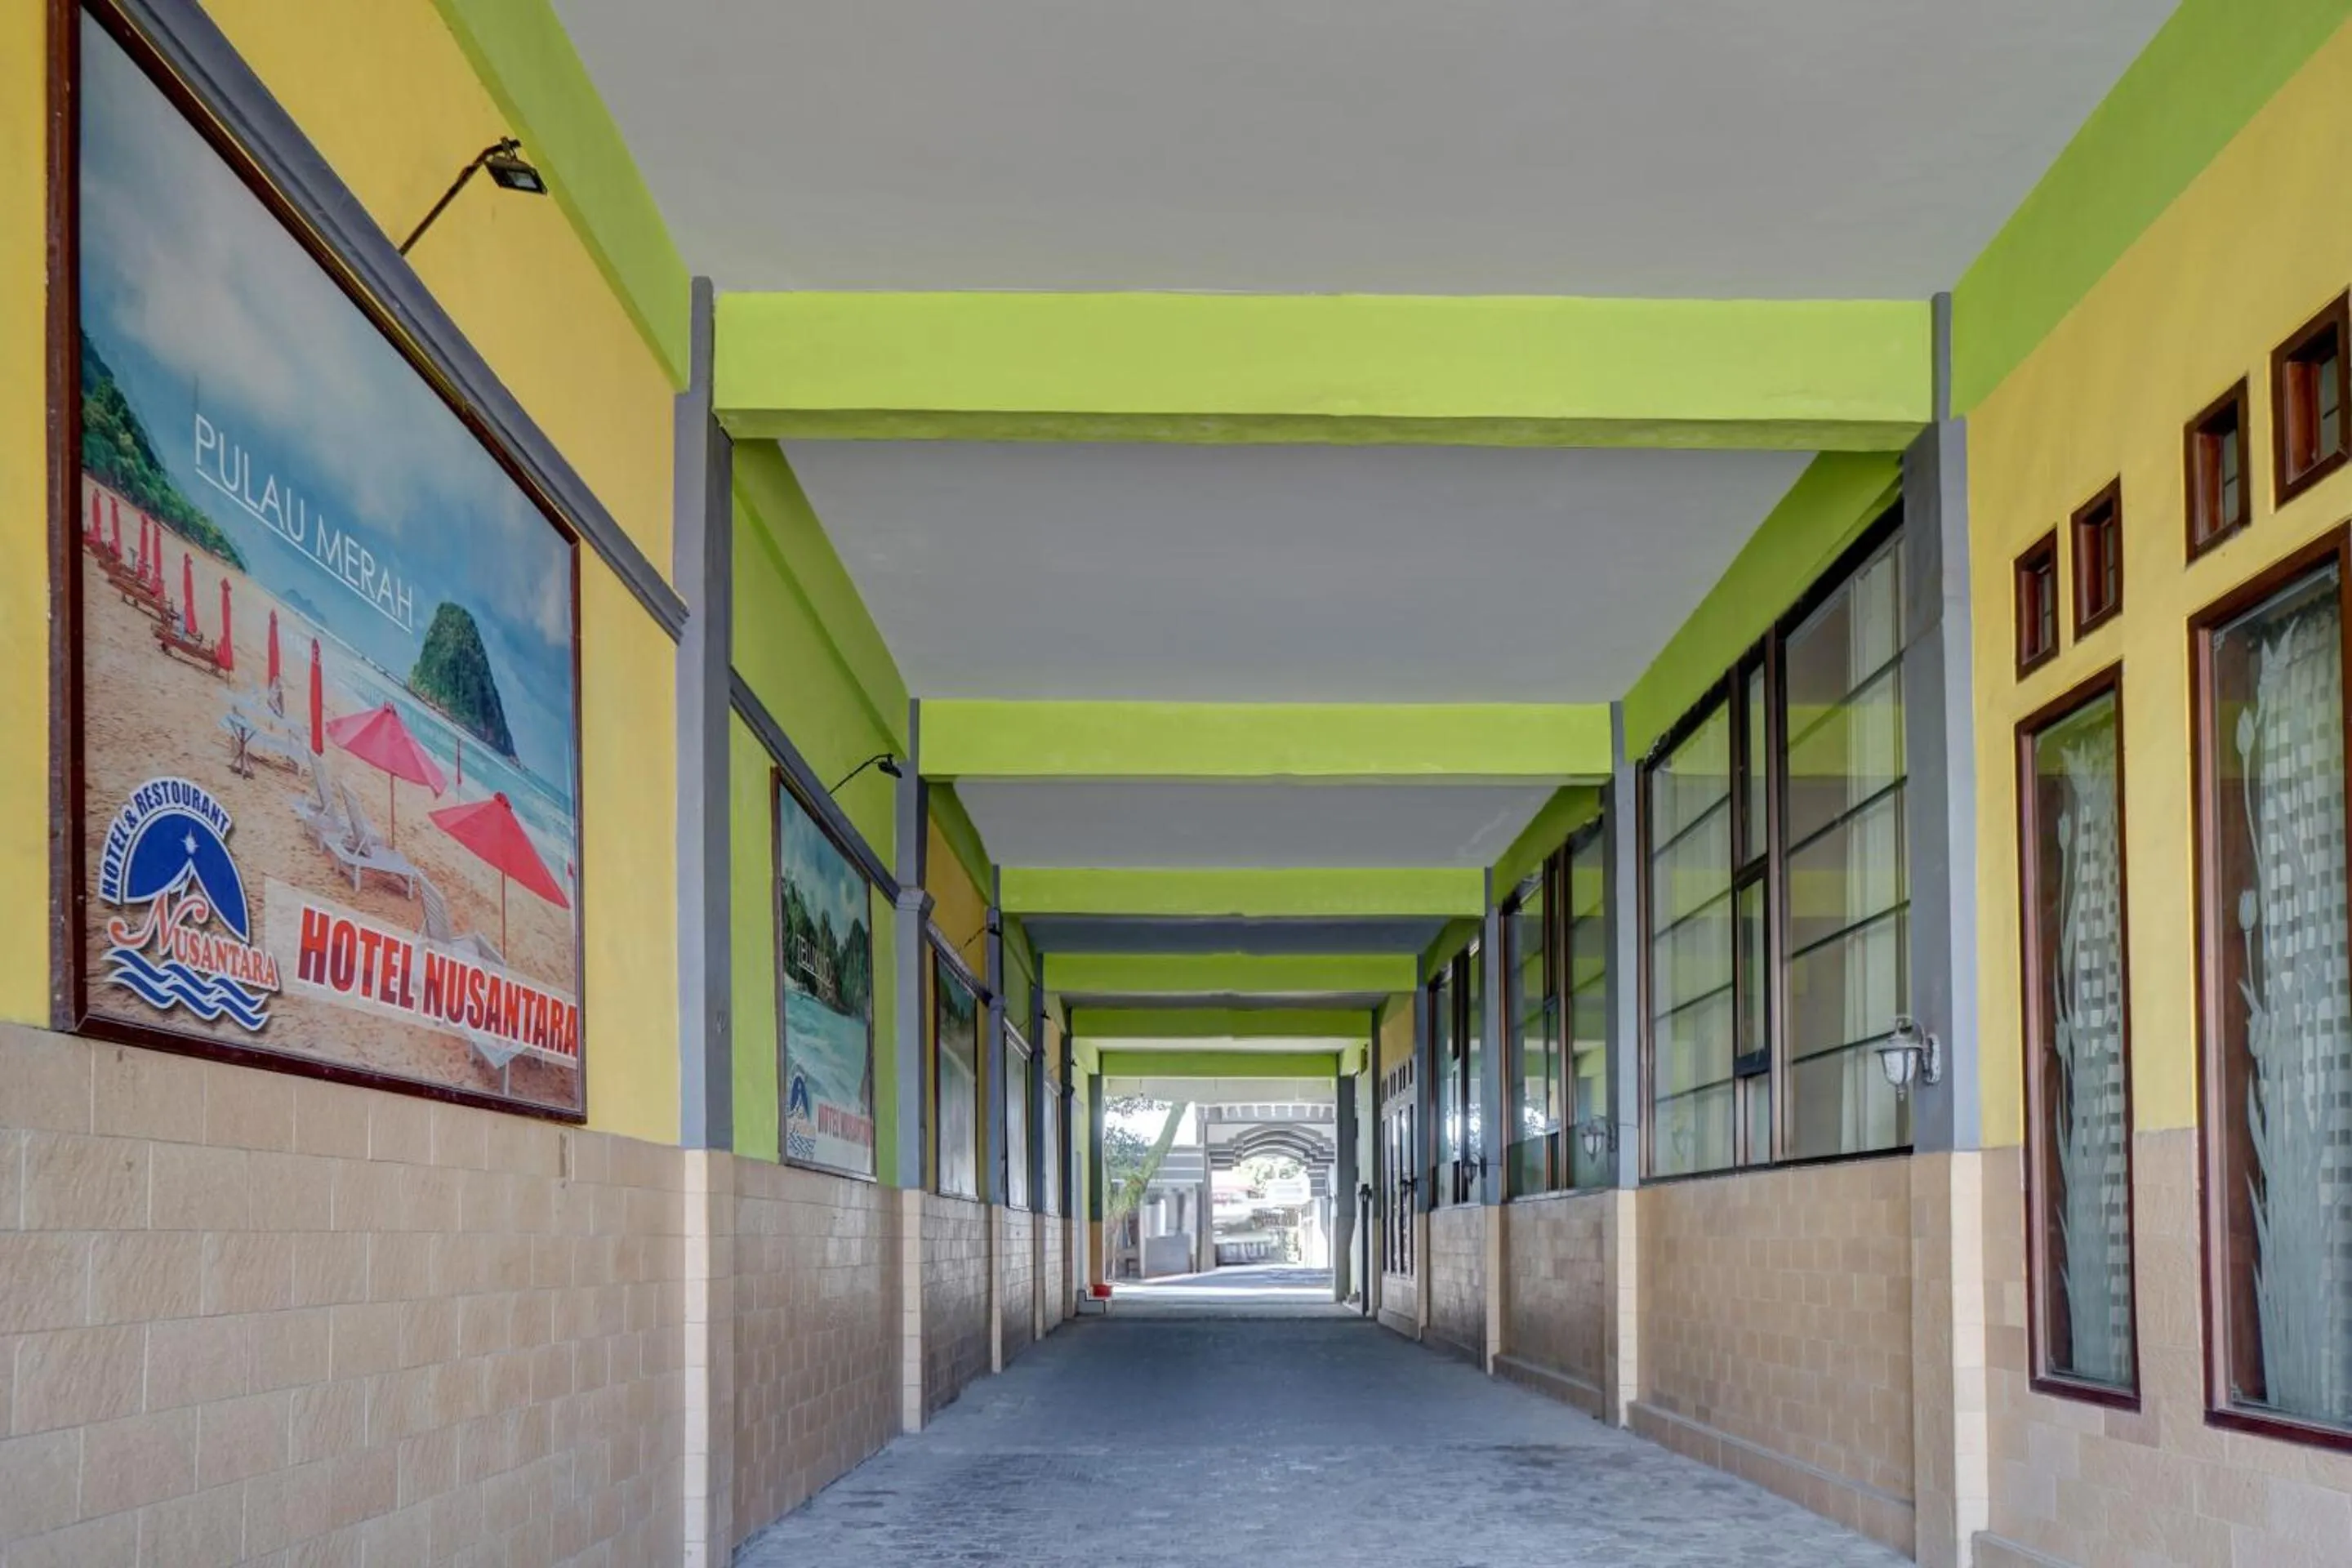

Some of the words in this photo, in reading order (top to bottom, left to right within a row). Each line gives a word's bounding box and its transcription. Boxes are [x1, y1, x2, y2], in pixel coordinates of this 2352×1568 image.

[195, 413, 305, 542] PULAU
[315, 514, 413, 627] MERAH
[101, 820, 131, 898] HOTEL
[124, 808, 139, 831] &
[133, 780, 229, 834] RESTOURANT
[297, 906, 415, 1010] HOTEL
[422, 951, 577, 1054] NUSANTARA
